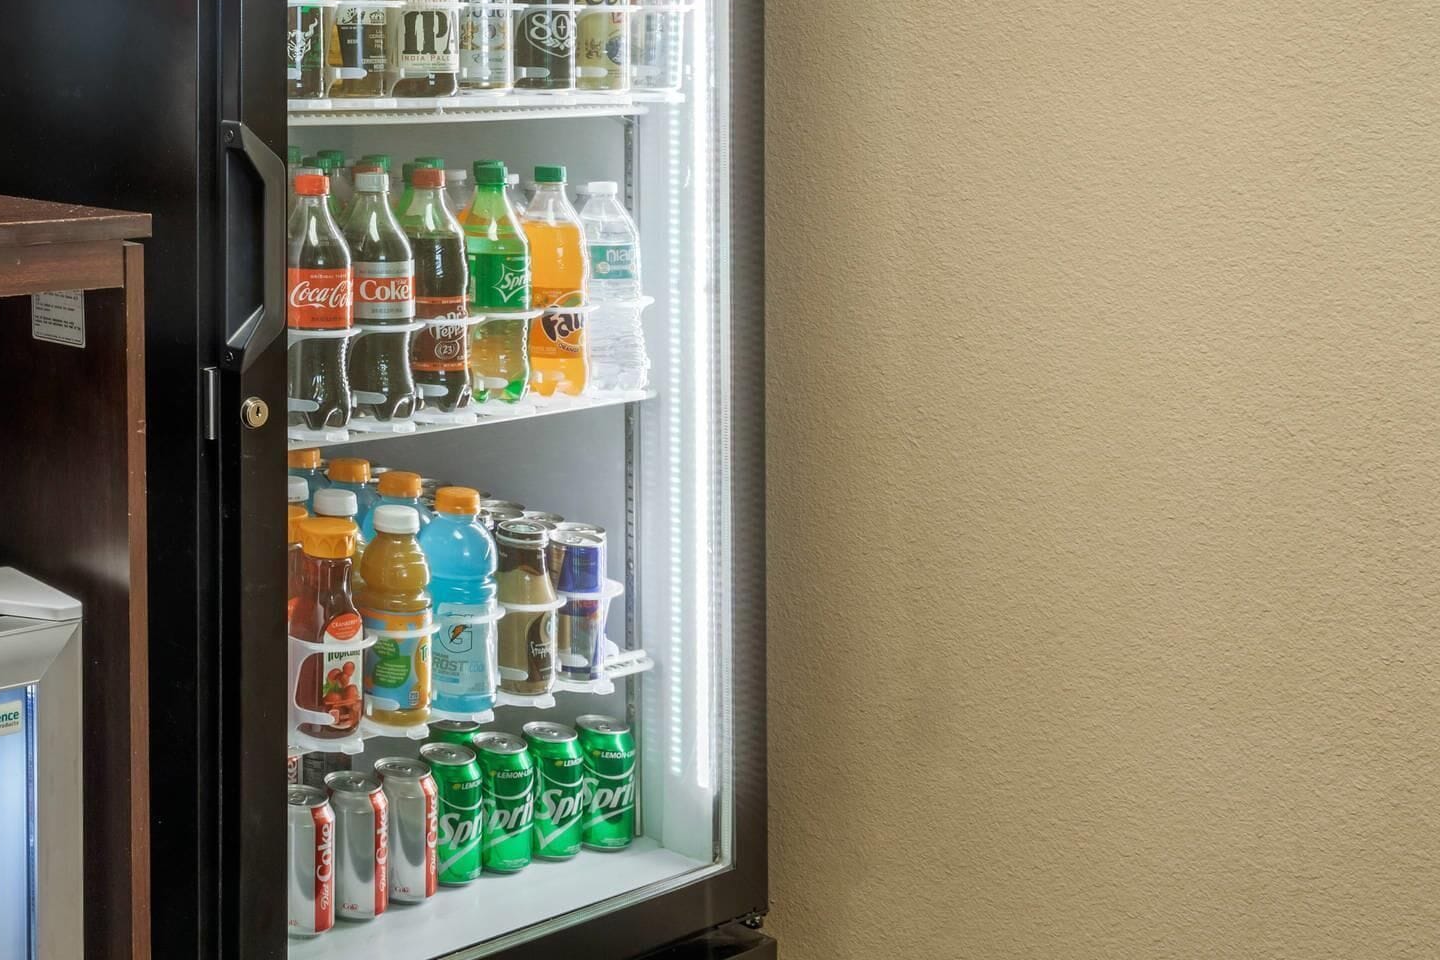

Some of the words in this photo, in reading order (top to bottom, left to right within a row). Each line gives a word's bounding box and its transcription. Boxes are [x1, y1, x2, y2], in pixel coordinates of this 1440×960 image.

[360, 279, 410, 302] Coke
[442, 344, 455, 355] 23
[376, 811, 388, 865] Coke
[427, 795, 438, 849] Coke
[317, 823, 332, 882] Coke
